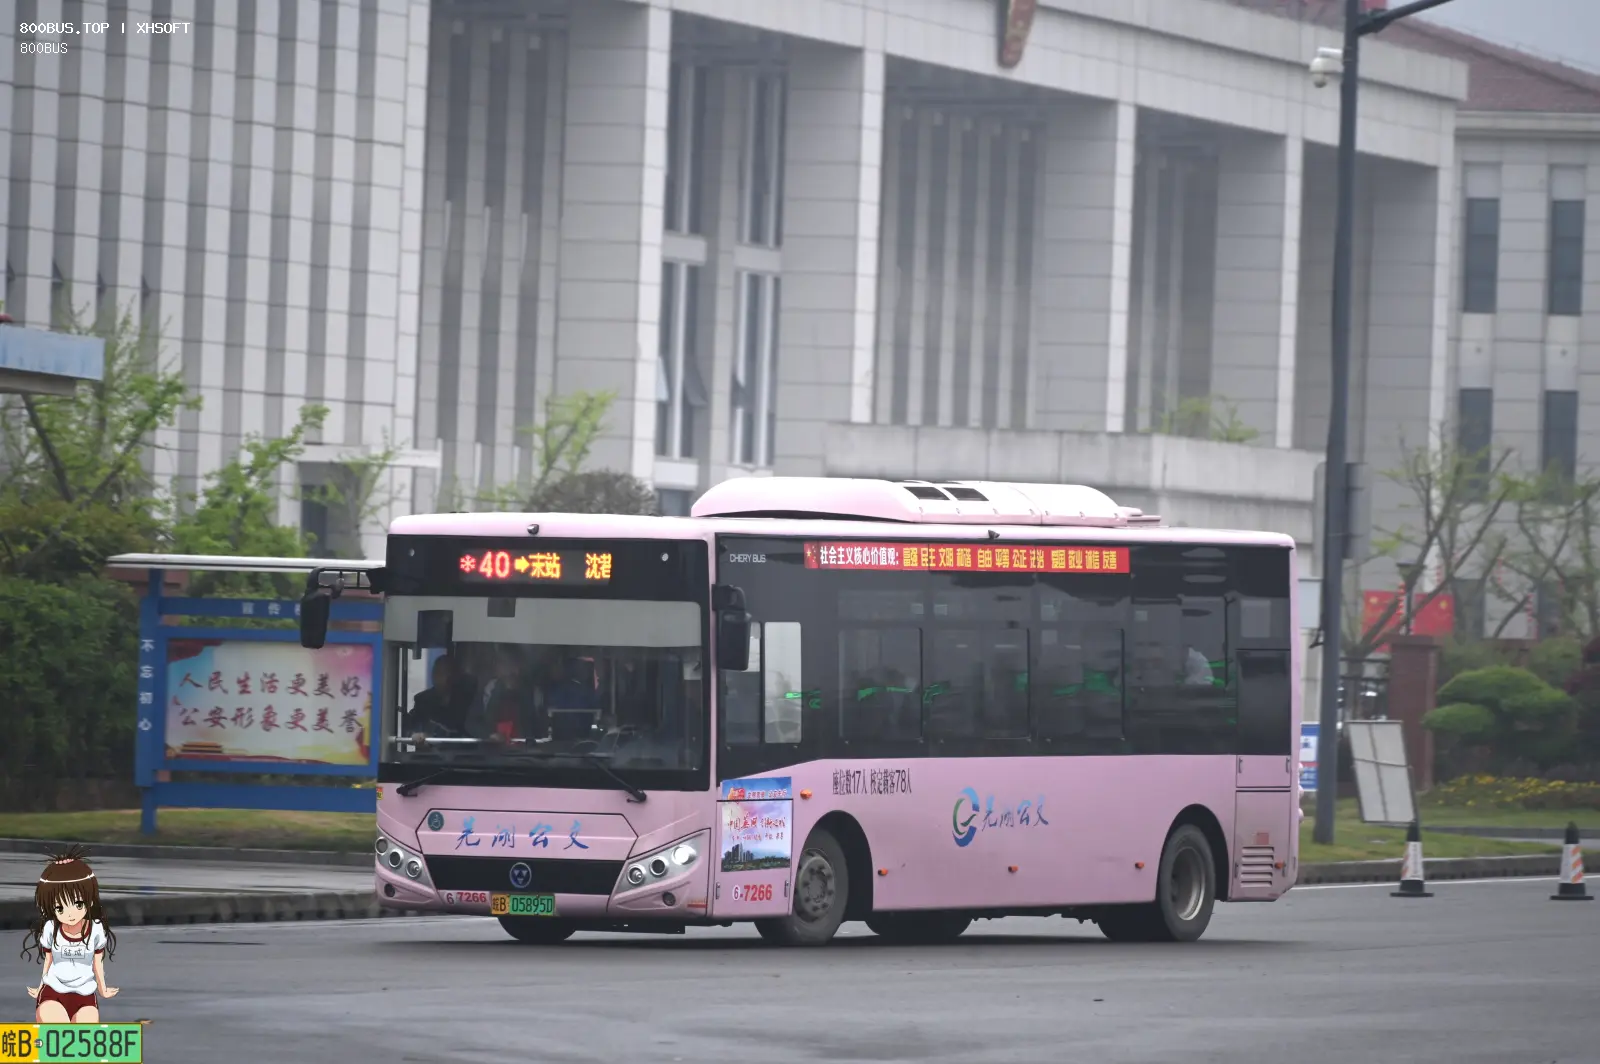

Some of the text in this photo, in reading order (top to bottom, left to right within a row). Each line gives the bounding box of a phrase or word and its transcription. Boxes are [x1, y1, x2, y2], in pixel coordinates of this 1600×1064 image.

[478, 551, 511, 579] 40
[528, 552, 561, 579] 末站
[729, 553, 767, 563] CHERY BUS
[902, 547, 918, 567] 富强
[920, 547, 936, 567] 民主
[938, 548, 954, 567] 文明
[956, 548, 971, 568] 和谐
[977, 548, 992, 568] 自由
[995, 549, 1010, 568] 平等
[1012, 549, 1027, 569] 公正
[1030, 549, 1044, 569] 法治
[1051, 549, 1066, 569] 爱国
[1068, 550, 1082, 569] 敬业
[1085, 550, 1100, 570] 诚信
[1102, 550, 1117, 570] 友善
[138, 639, 155, 731] 不忘初心
[178, 671, 362, 699] 人民生活更美好
[178, 704, 364, 734] 公安形象更美誉
[732, 884, 773, 902] 6-7266
